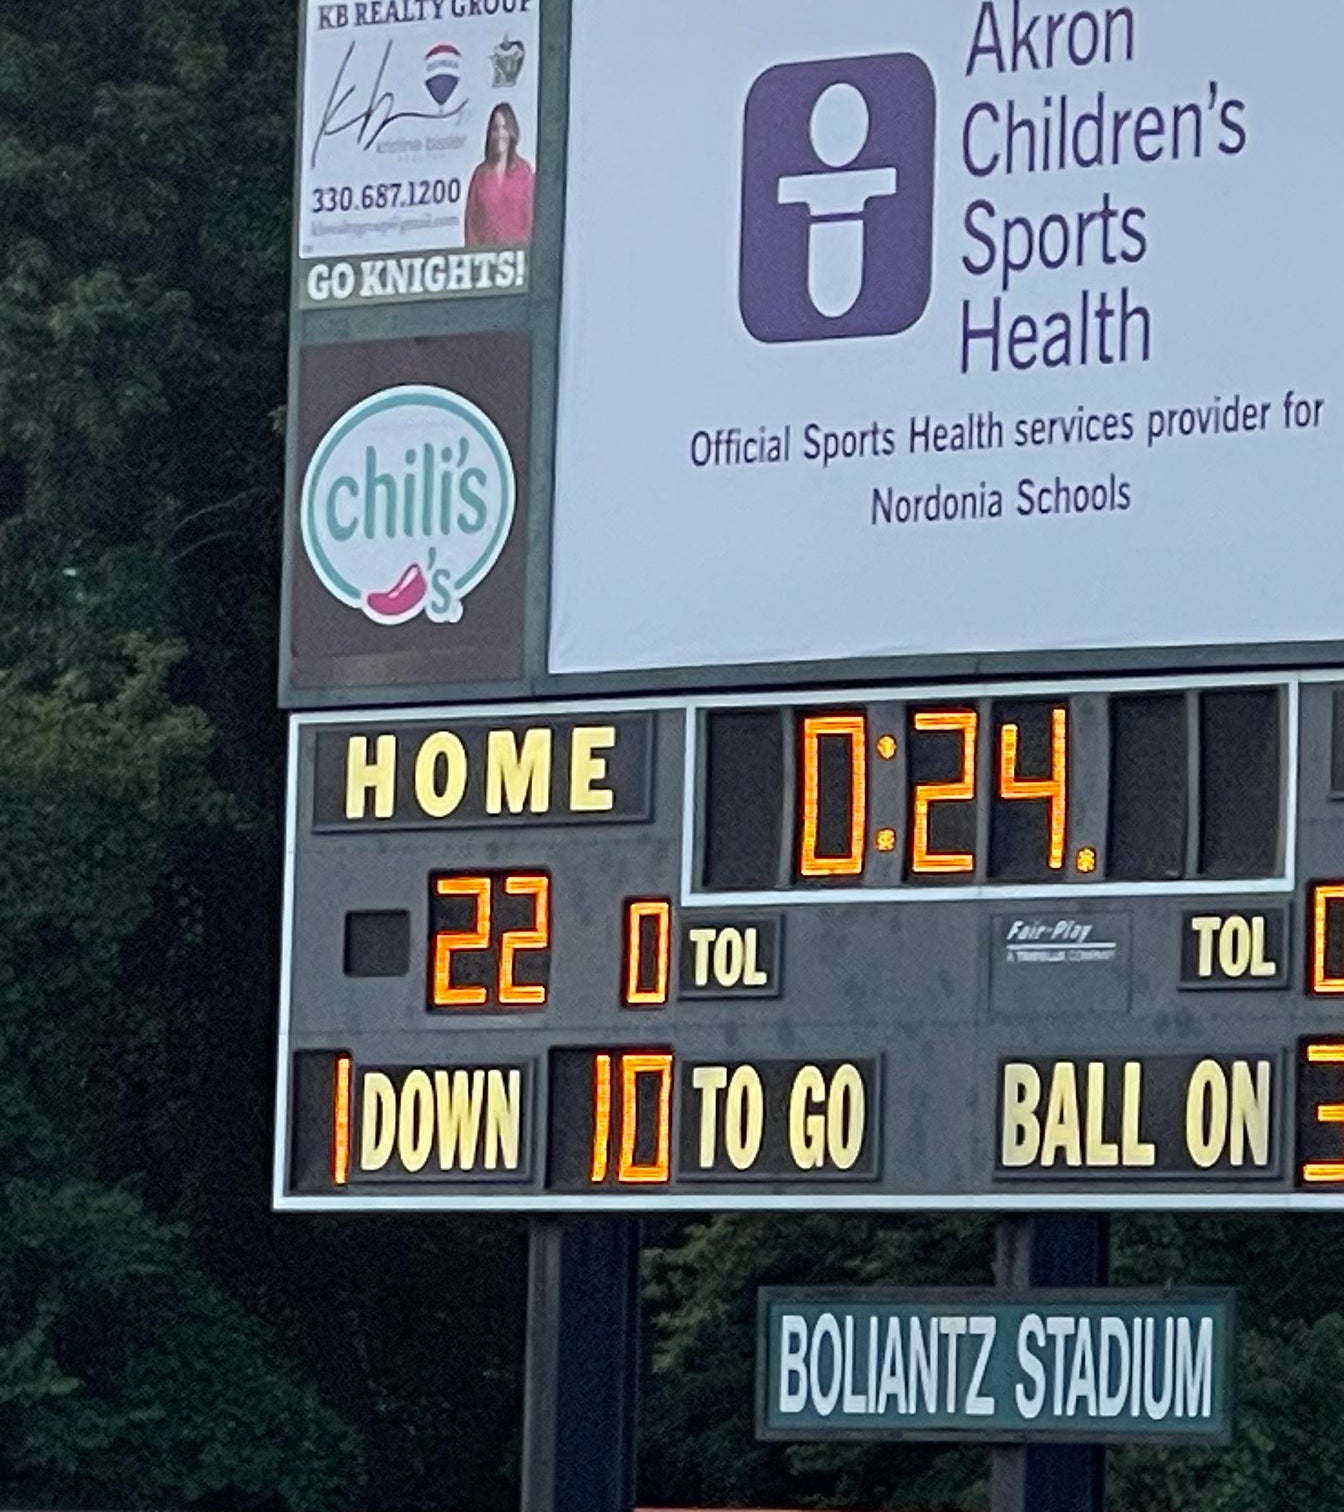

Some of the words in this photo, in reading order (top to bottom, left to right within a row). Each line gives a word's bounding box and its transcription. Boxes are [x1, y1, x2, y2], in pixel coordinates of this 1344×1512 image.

[318, 4, 348, 30] KB
[962, 81, 1247, 178] Children's
[312, 178, 461, 213] 330.687.1200
[962, 192, 1148, 292] Sports
[307, 262, 354, 300] GO
[359, 250, 526, 297] KNIGHTS!
[961, 287, 1151, 374] Health
[690, 425, 791, 468] Official
[803, 419, 896, 468] Sports
[908, 412, 1004, 456] Health
[1013, 405, 1135, 447] services
[1147, 395, 1272, 447] provider
[1282, 390, 1325, 429] for
[326, 437, 488, 543] chili's
[870, 480, 1003, 525] Nordonia
[1017, 473, 1131, 517] Schools
[345, 725, 617, 819] HOME
[432, 876, 551, 1006] 22
[626, 900, 670, 1005] 0
[689, 927, 768, 987] TOL
[1006, 920, 1093, 943] Fair-Play
[1192, 915, 1276, 978] TOL
[332, 1057, 352, 1185] 1
[360, 1069, 521, 1173] DOWN
[590, 1054, 673, 1183] 10
[692, 1064, 764, 1170] TO
[788, 1062, 866, 1171] GO
[1001, 1060, 1155, 1167] BALL
[1185, 1058, 1271, 1167] ON
[778, 1312, 997, 1417] BOLIANTZ
[1014, 1314, 1213, 1420] STADIUM
